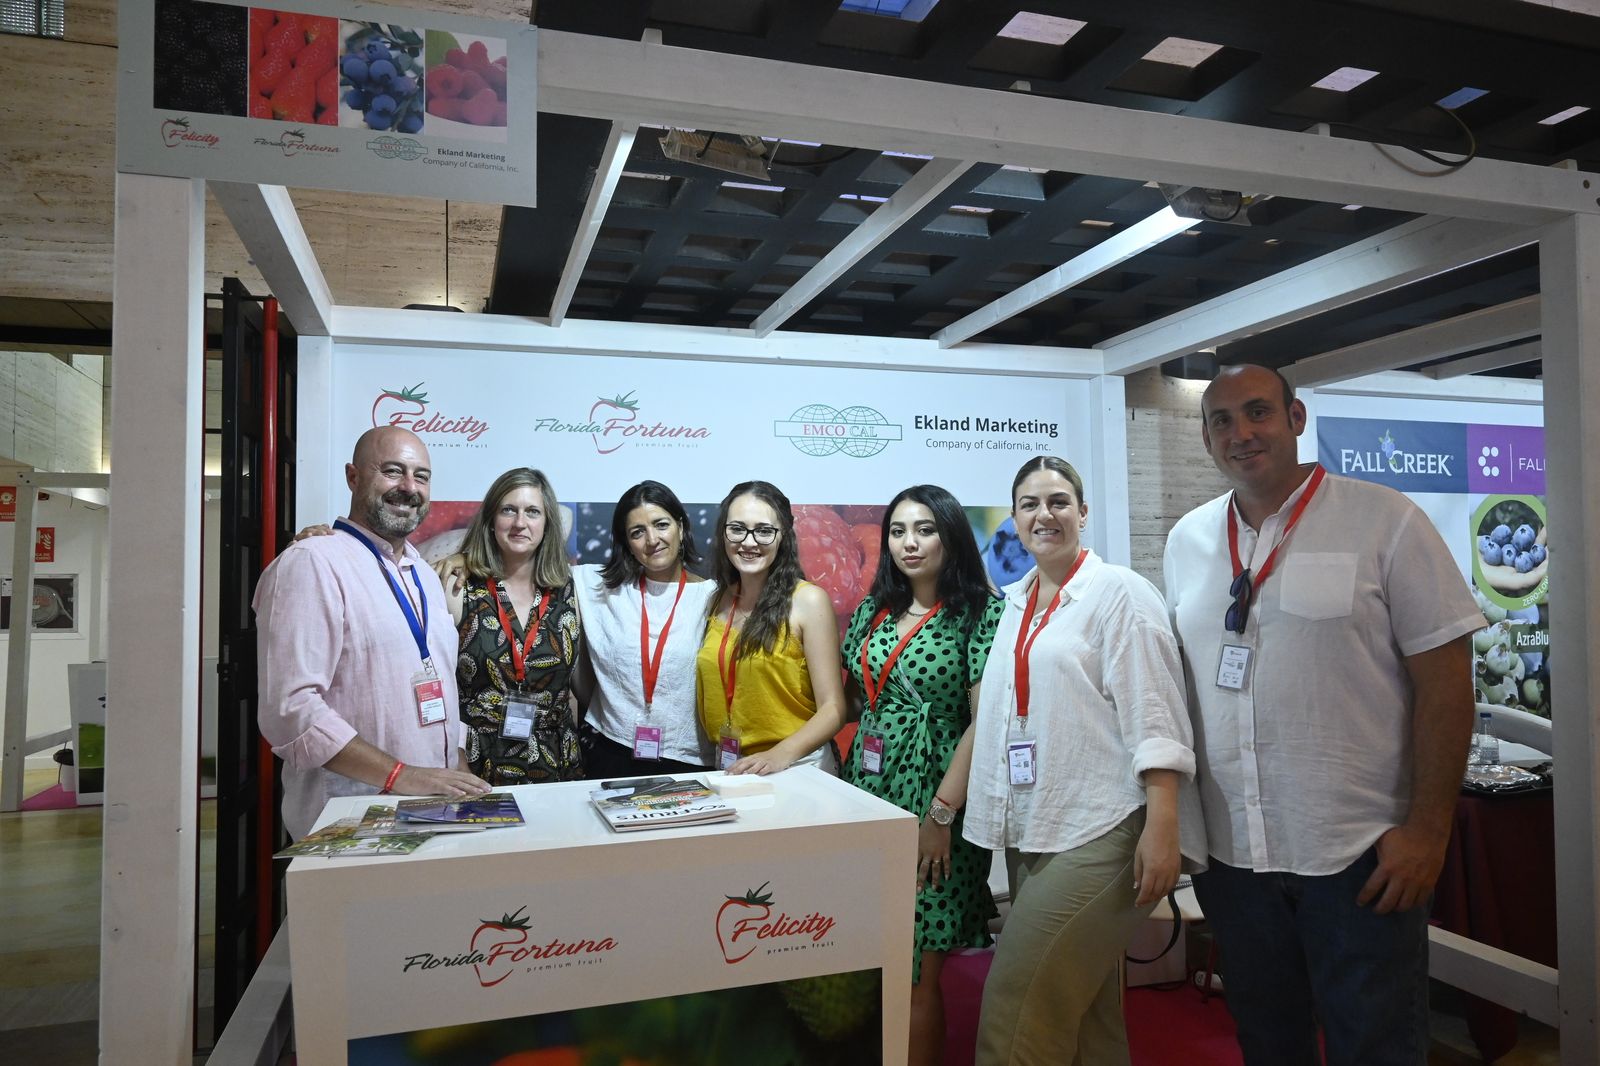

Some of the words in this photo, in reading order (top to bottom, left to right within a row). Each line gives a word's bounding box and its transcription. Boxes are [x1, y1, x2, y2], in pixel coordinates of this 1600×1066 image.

[169, 128, 220, 146] Felicity
[287, 139, 341, 153] Fortuna
[437, 148, 464, 157] Ekland
[465, 151, 506, 162] Marketing
[422, 157, 458, 168] Company
[459, 160, 467, 168] of
[469, 162, 505, 172] California,
[506, 164, 519, 173] Inc.
[388, 411, 490, 442] Felicity
[534, 418, 603, 433] Florida
[602, 418, 712, 439] Fortuna
[803, 423, 846, 437] EMCO
[849, 425, 878, 438] CAL
[914, 415, 971, 432] Ekland
[975, 417, 1059, 438] Marketing
[925, 438, 972, 451] Company
[974, 439, 985, 450] of
[986, 439, 1033, 452] California,
[1035, 442, 1052, 452] Inc.
[1340, 448, 1386, 474] FALL
[1388, 450, 1452, 477] CREEK
[1518, 457, 1546, 471] FAL
[731, 912, 836, 942] Felicity
[403, 949, 488, 973] Florida
[486, 938, 619, 967] Fortuna
[767, 945, 807, 955] premium
[812, 941, 834, 949] fruit
[526, 961, 572, 973] premium
[577, 958, 603, 966] fruit
